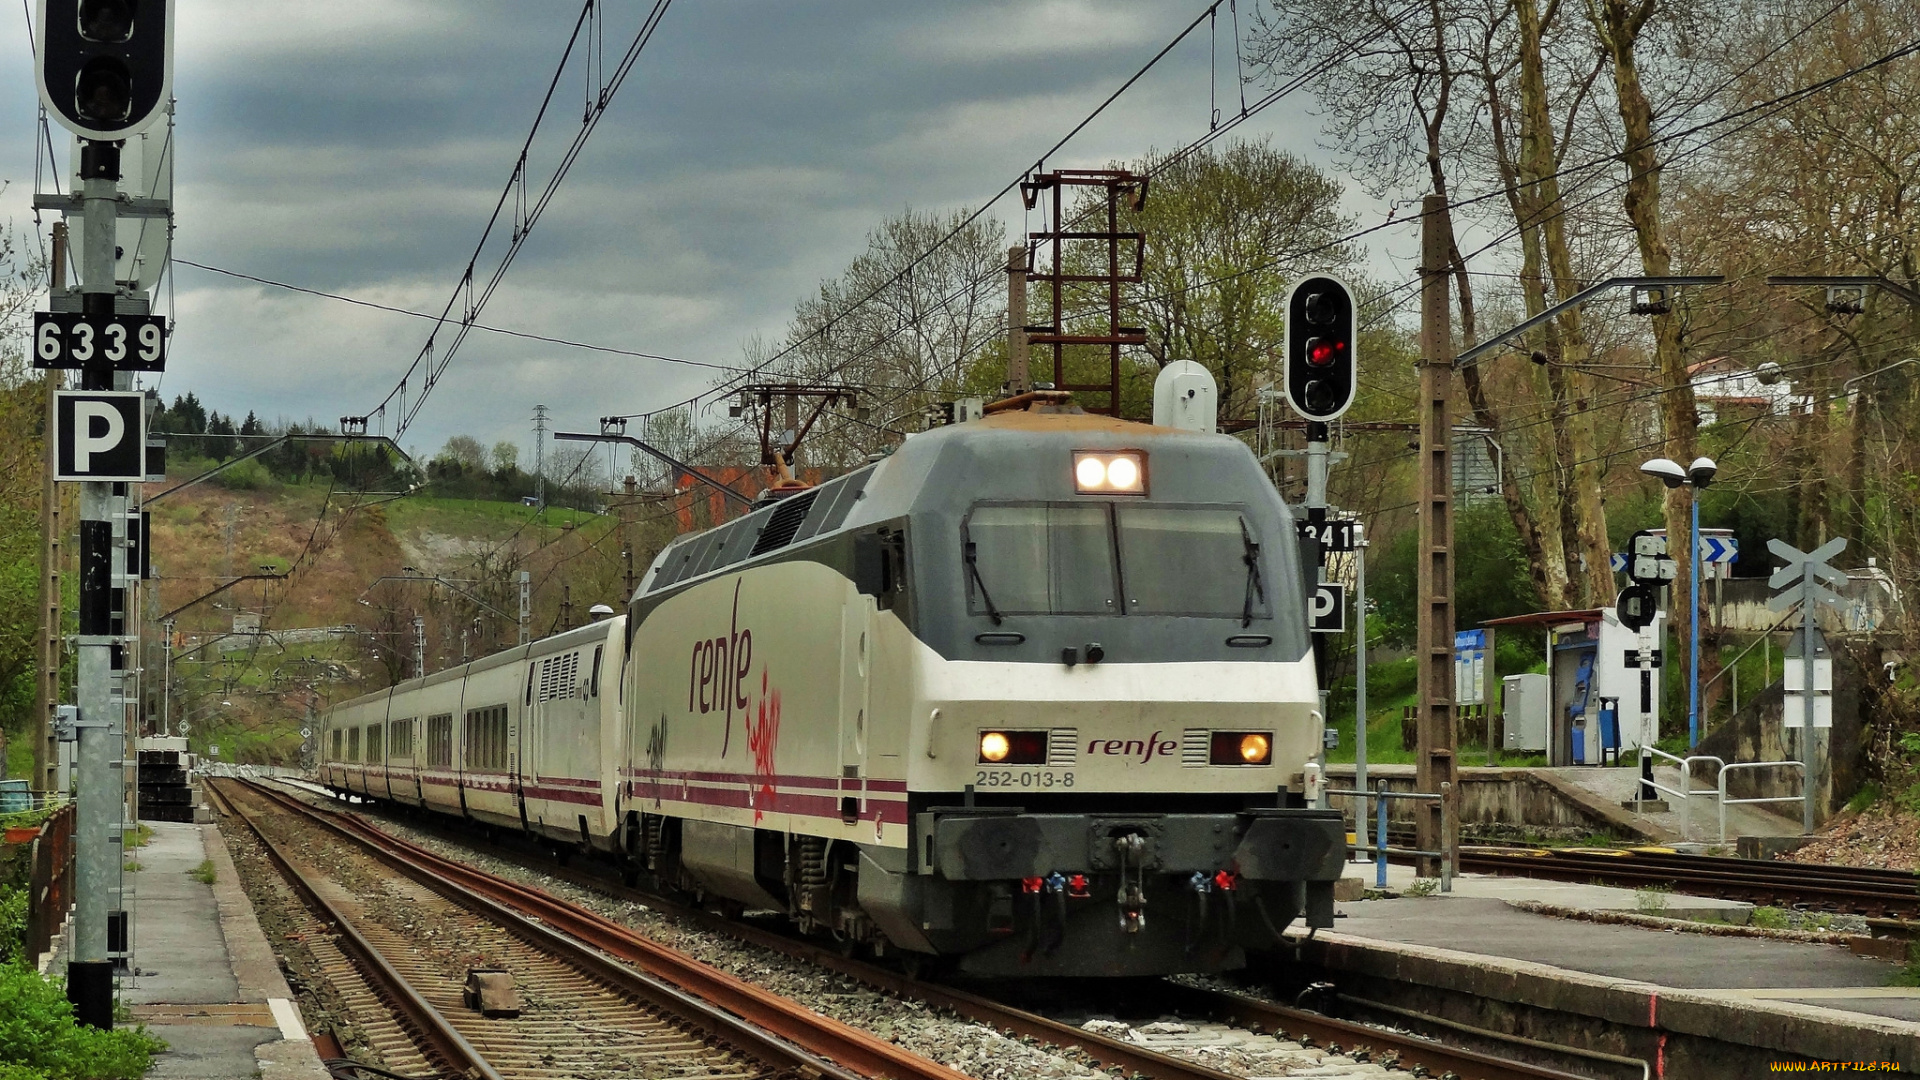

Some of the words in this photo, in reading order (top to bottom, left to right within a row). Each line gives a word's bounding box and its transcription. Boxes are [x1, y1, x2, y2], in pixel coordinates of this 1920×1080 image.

[38, 322, 161, 362] 6339
[74, 400, 125, 473] P
[1295, 525, 1349, 548] 341
[1308, 588, 1335, 628] P
[689, 576, 752, 760] renfe
[1087, 729, 1178, 764] renfe
[976, 771, 1075, 788] 252-013-8
